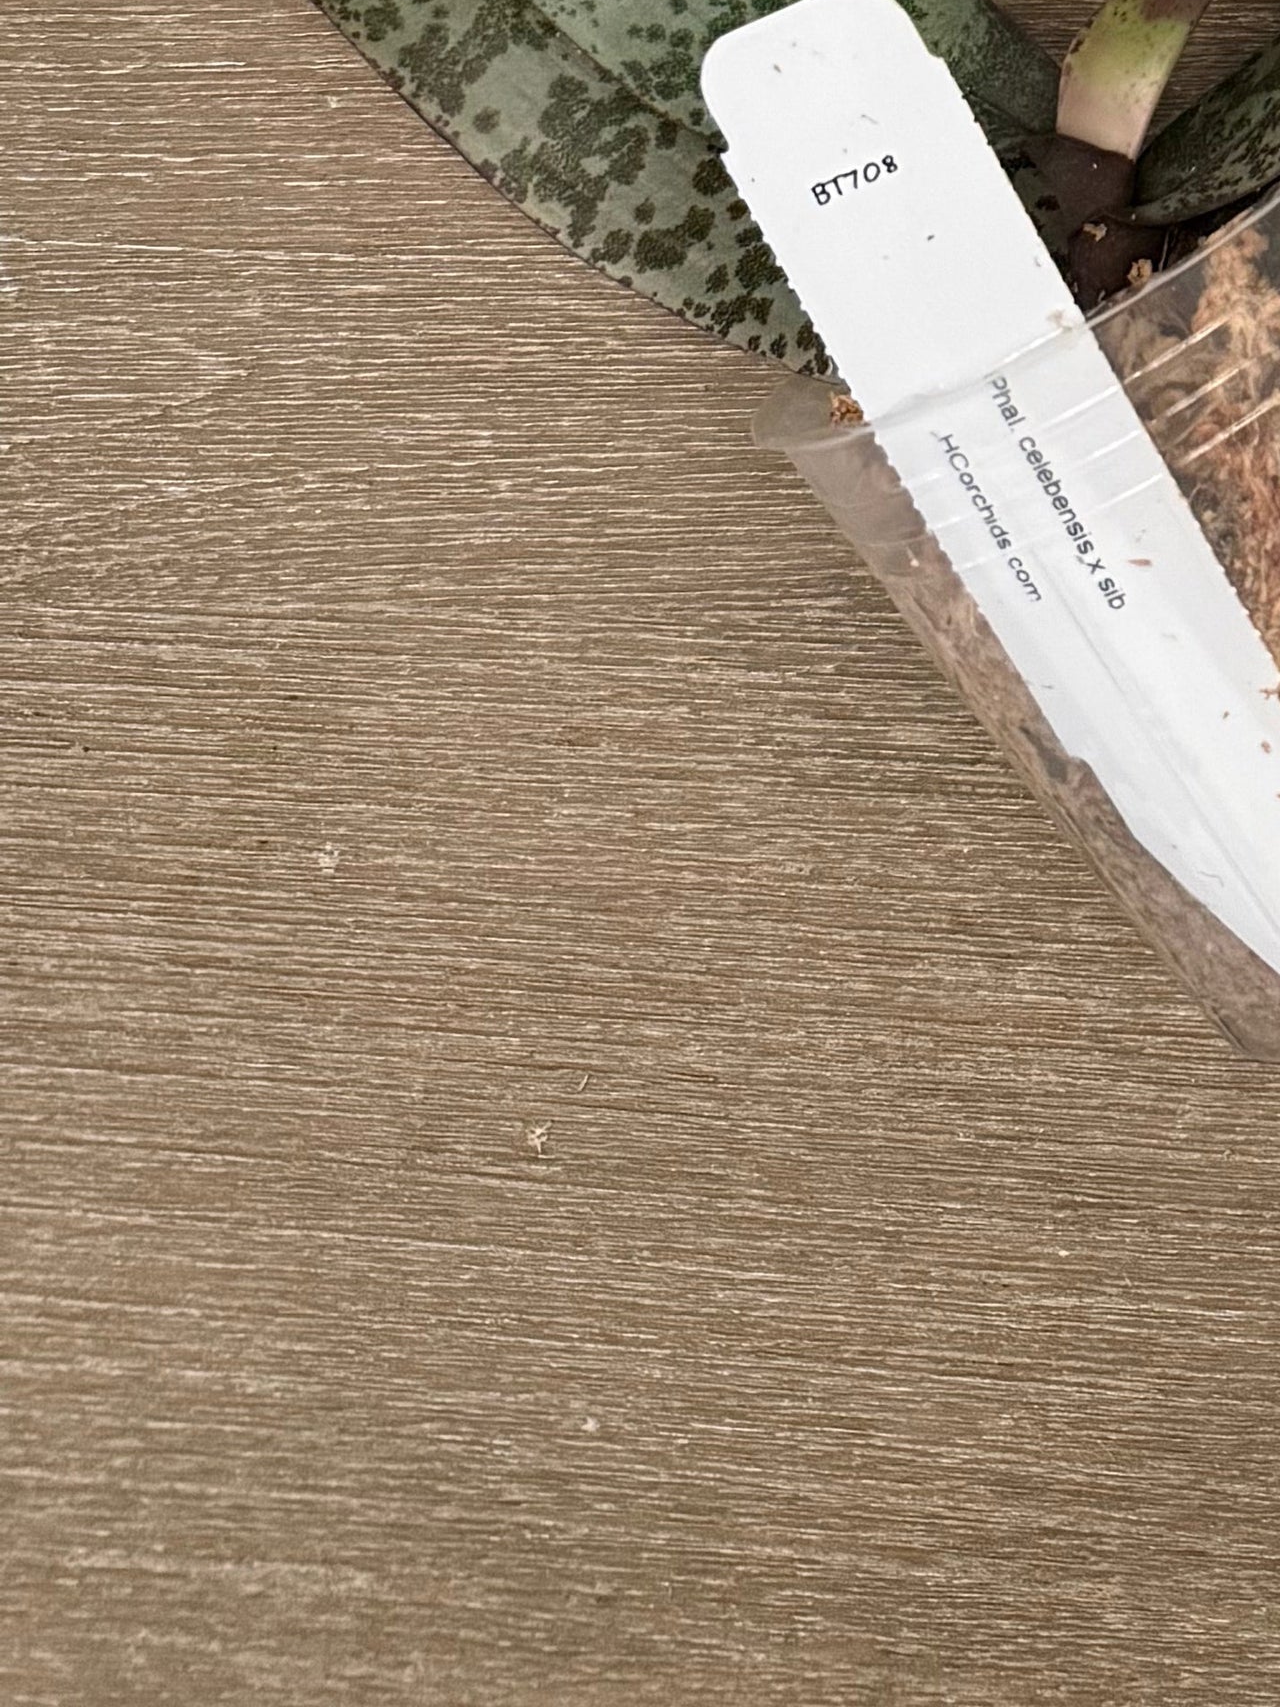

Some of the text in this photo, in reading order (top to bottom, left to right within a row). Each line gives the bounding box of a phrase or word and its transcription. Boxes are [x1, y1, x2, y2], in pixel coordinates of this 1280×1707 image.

[811, 154, 899, 206] BT708
[1018, 436, 1095, 555] celebensis
[1098, 577, 1126, 611] sib
